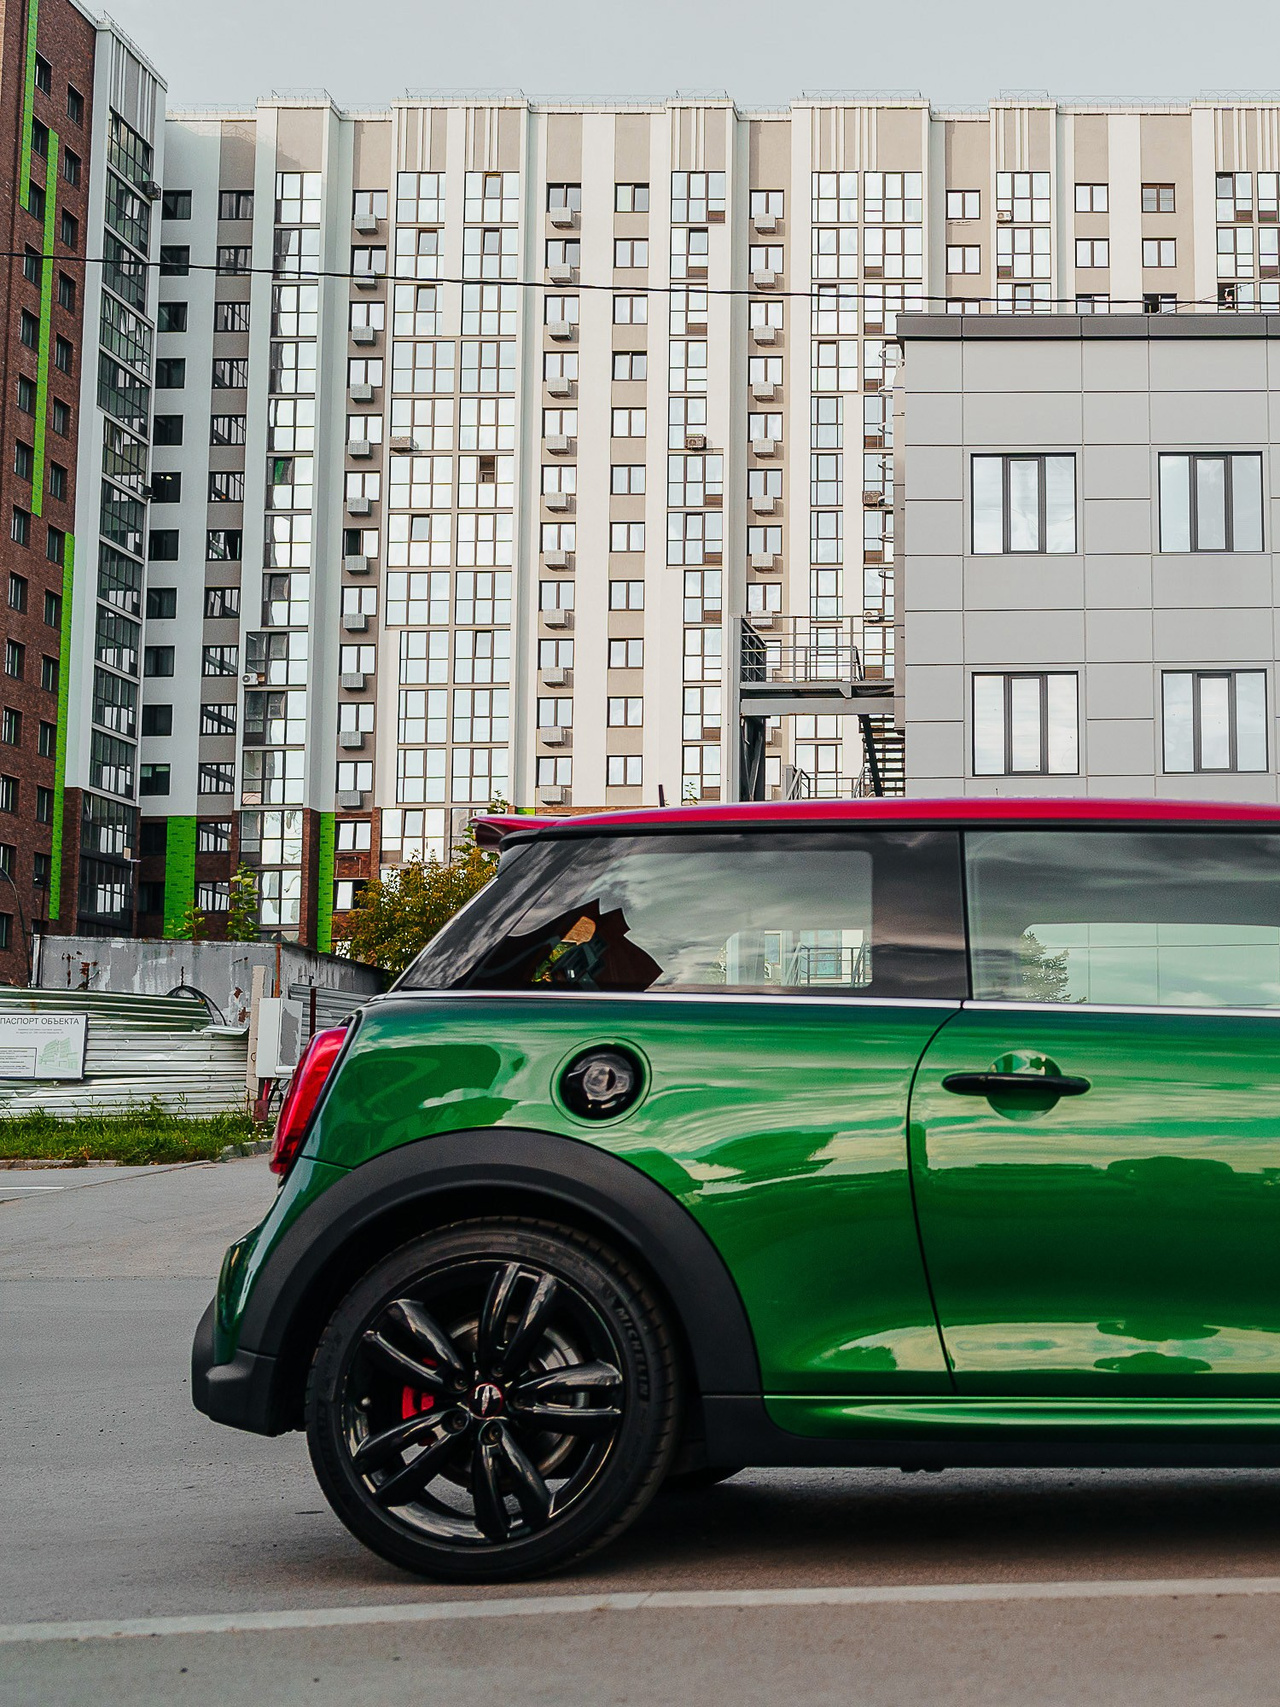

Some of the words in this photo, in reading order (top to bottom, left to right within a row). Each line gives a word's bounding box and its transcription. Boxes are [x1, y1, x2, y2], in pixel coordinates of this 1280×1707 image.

[0, 1017, 39, 1025] ПАСПОРТ
[41, 1017, 80, 1025] ОБЪЕКТА
[616, 1307, 649, 1396] MICHELIN
